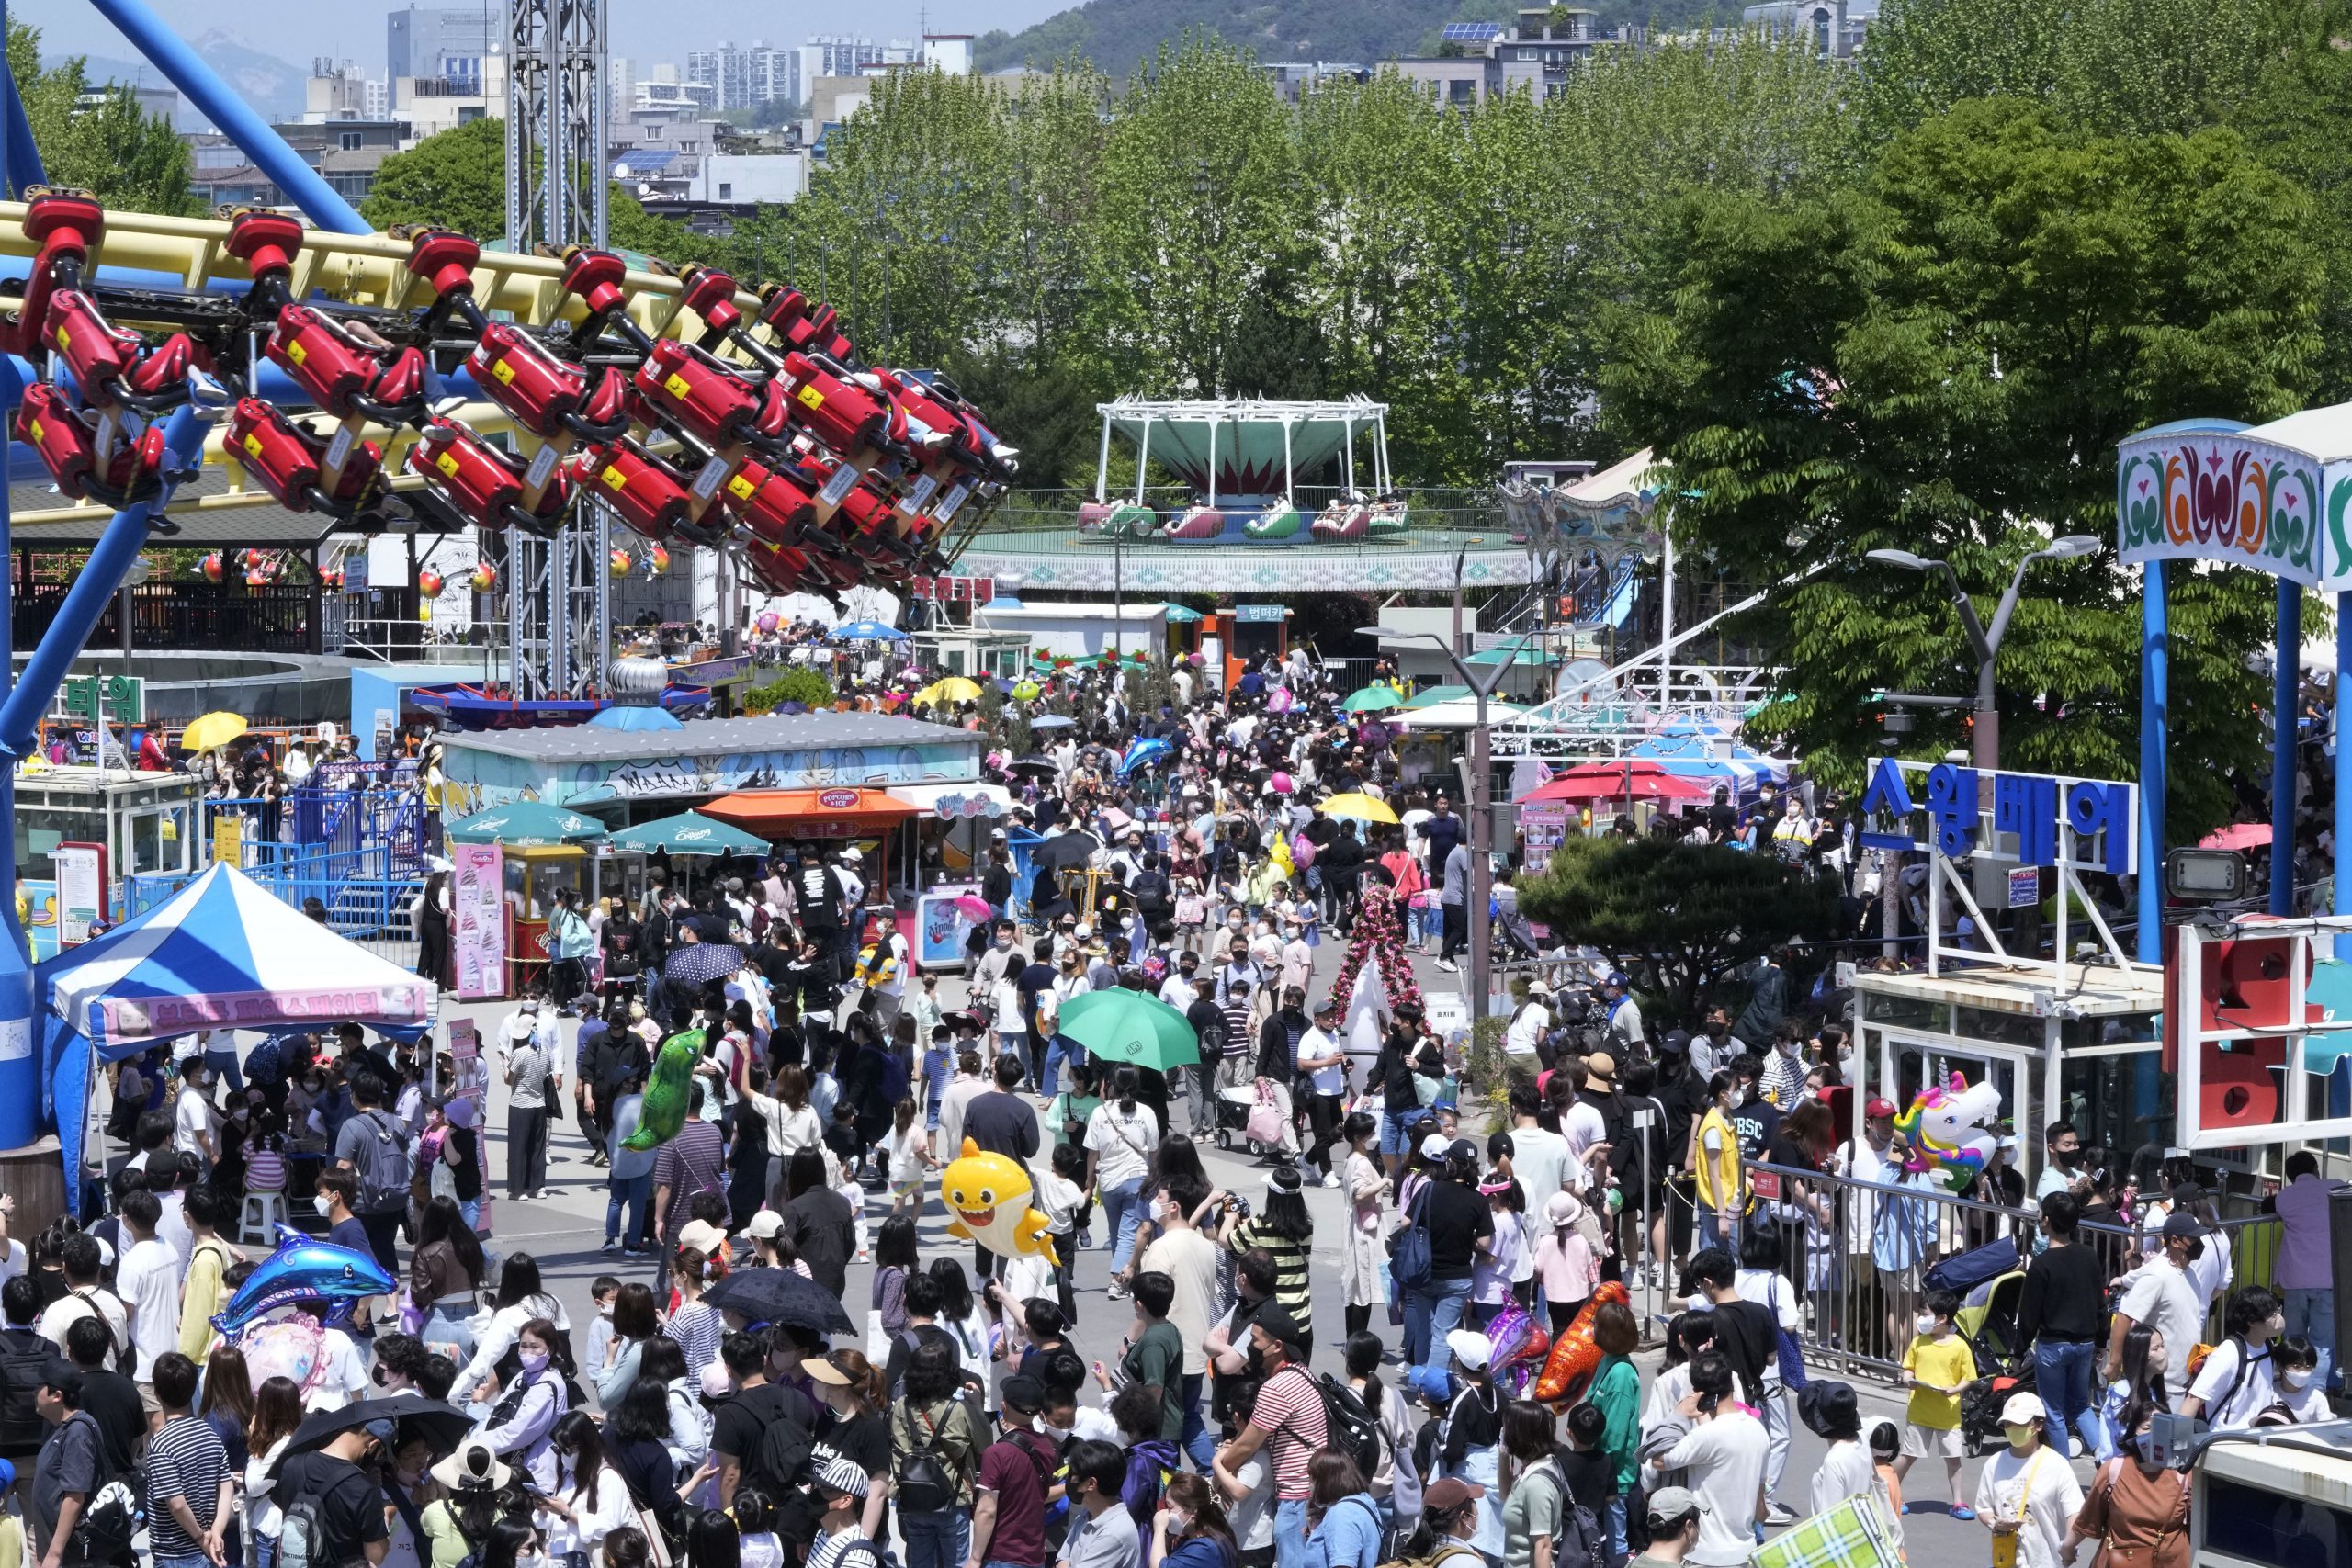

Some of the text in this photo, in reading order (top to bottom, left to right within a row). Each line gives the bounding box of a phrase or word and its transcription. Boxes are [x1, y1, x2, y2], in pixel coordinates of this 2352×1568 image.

[1250, 606, 1283, 620] 범퍼카
[823, 793, 855, 802] POPCORN
[1860, 757, 2130, 874] 스윙베어
